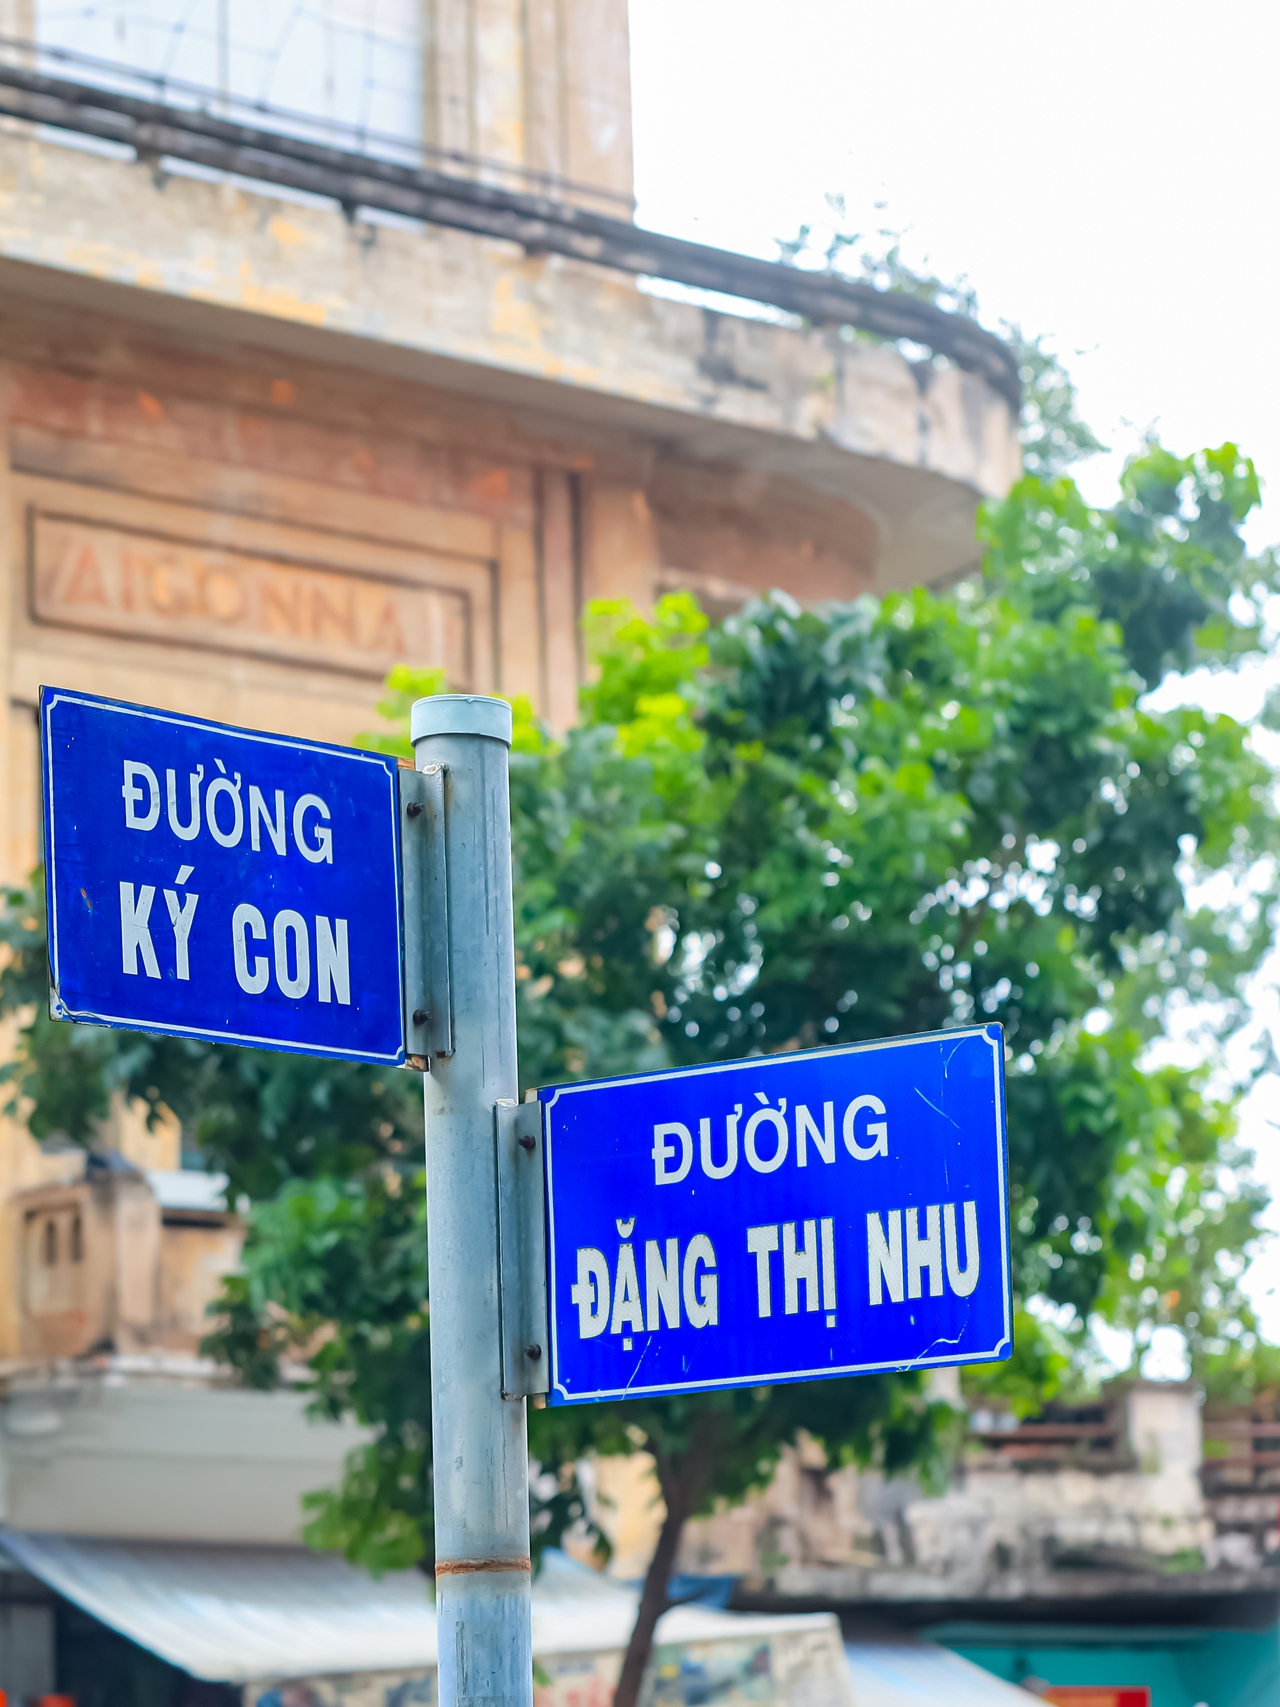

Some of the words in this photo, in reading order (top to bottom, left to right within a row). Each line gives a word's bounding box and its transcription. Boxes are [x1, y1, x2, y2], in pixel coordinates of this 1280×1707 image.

[122, 757, 333, 864] ĐƯỜNG
[119, 865, 199, 980] KÝ
[232, 903, 351, 1005] CON
[652, 1092, 889, 1186] ĐƯỜNG
[571, 1217, 718, 1351] ĐẶNG
[747, 1217, 836, 1328] THỊ
[867, 1200, 980, 1306] NHU
